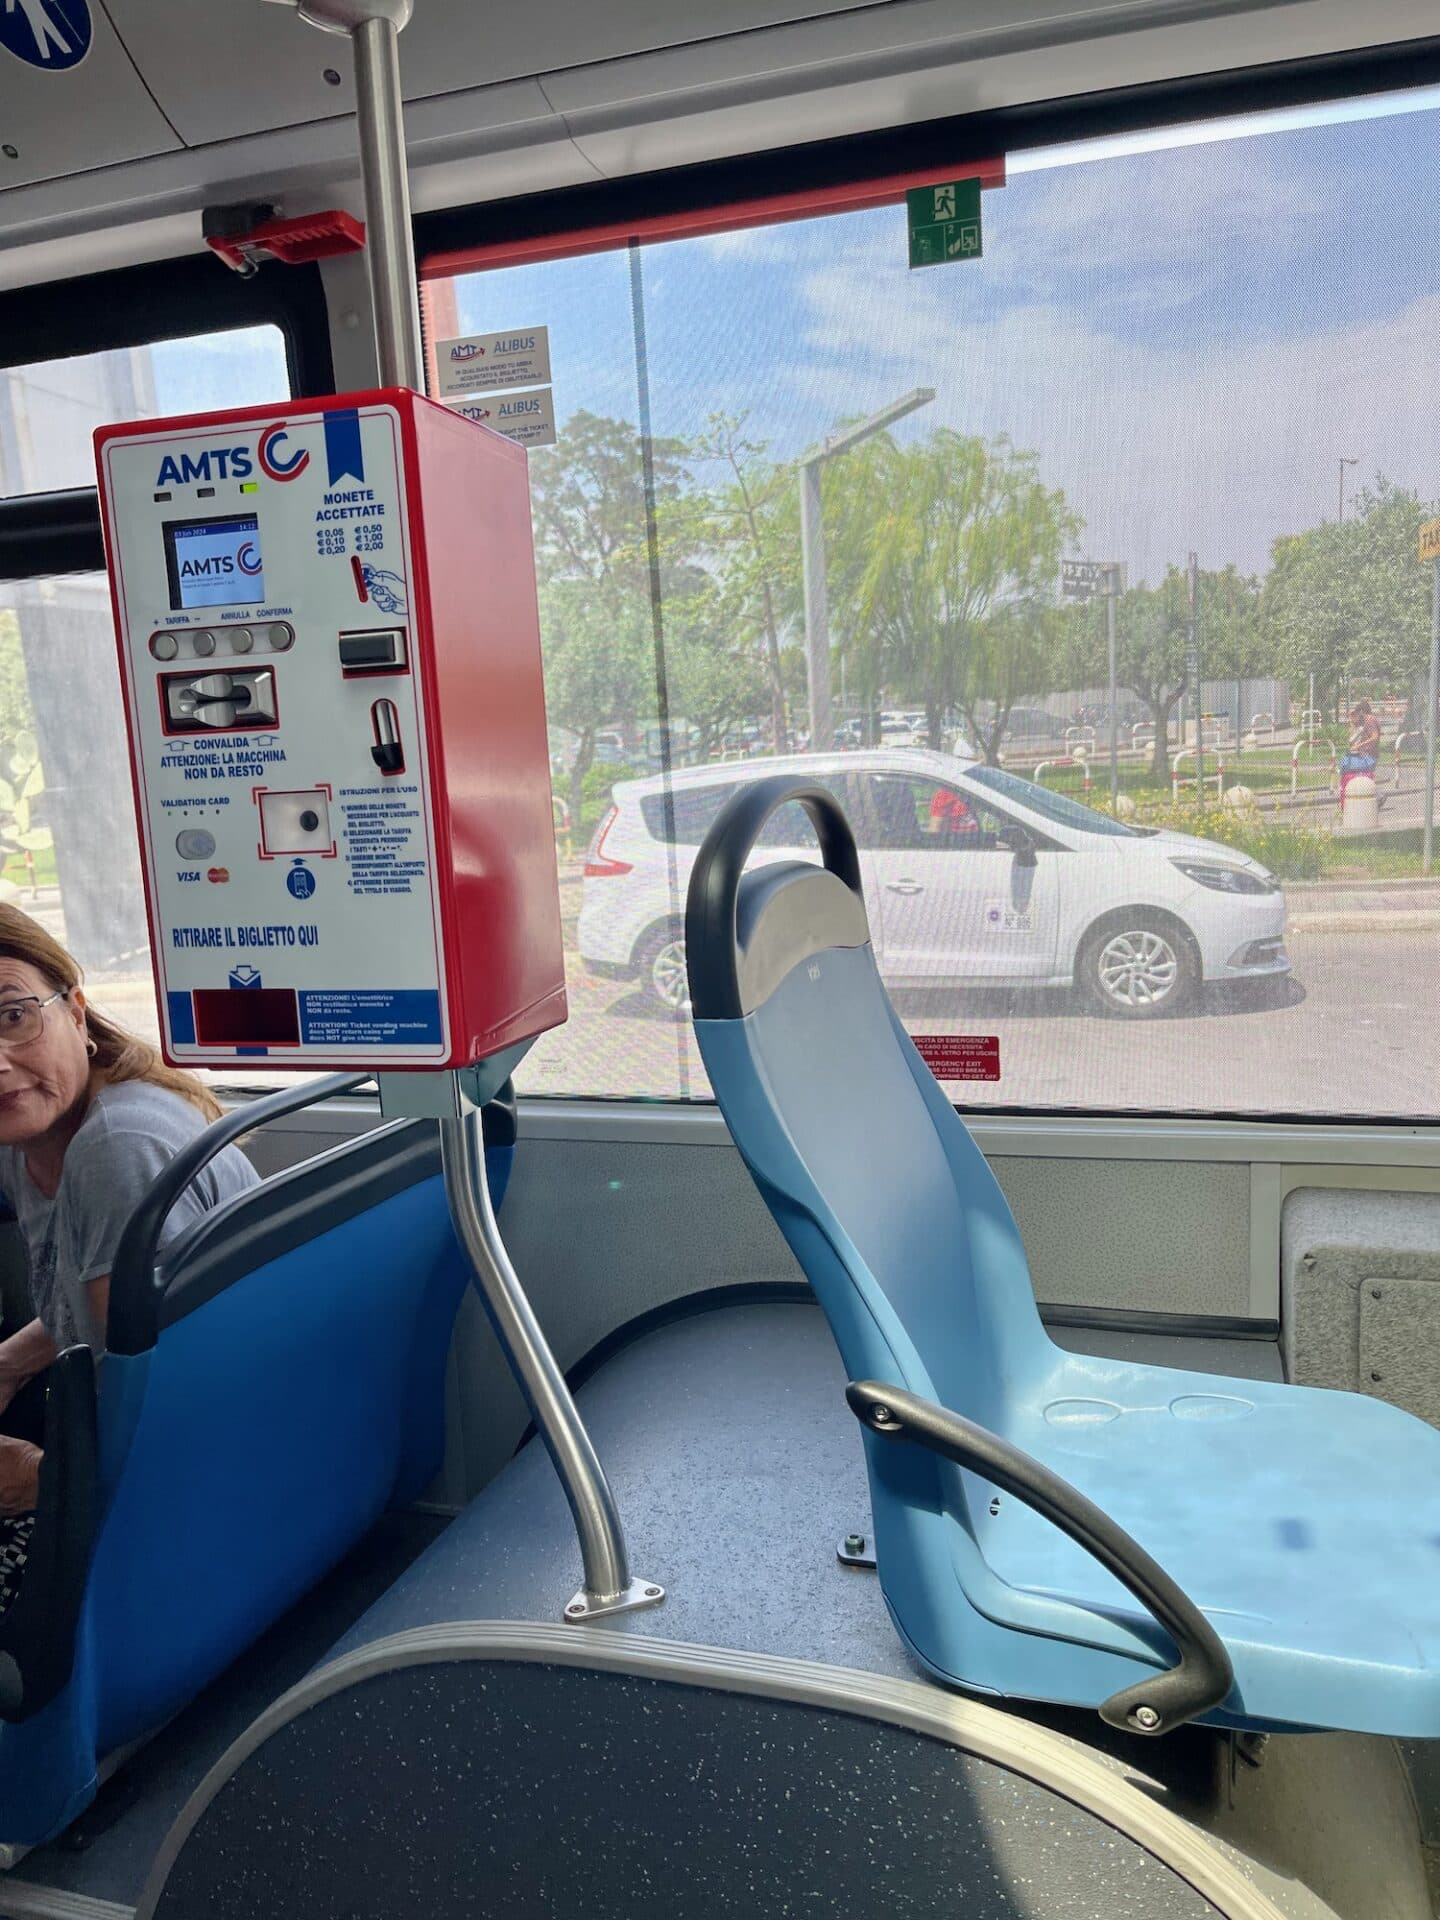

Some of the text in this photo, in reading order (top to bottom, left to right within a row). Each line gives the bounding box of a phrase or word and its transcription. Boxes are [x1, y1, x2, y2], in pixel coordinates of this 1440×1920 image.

[948, 224, 954, 234] 2
[451, 344, 477, 358] AMT
[494, 336, 535, 353] ALIBUS
[499, 400, 540, 416] ALIBUS
[156, 446, 252, 486] AMTS
[324, 490, 374, 504] MONETE
[316, 504, 385, 521] ACCETTATE
[181, 556, 234, 577] AMTS
[221, 611, 250, 620] ANNULLA
[256, 608, 293, 617] CONFERMA
[165, 616, 190, 625] TARIFFA
[194, 738, 249, 750] CONVALIDA
[161, 750, 286, 768] ATTENZIONE: LA MACCHINA
[184, 765, 264, 780] NON DA RESTO
[340, 787, 379, 795] ISTRUZIONI
[161, 797, 230, 807] VALIDATION CARD
[176, 872, 201, 882] VISA
[172, 925, 318, 948] RITIRARE IL BIGLIETTO QUI
